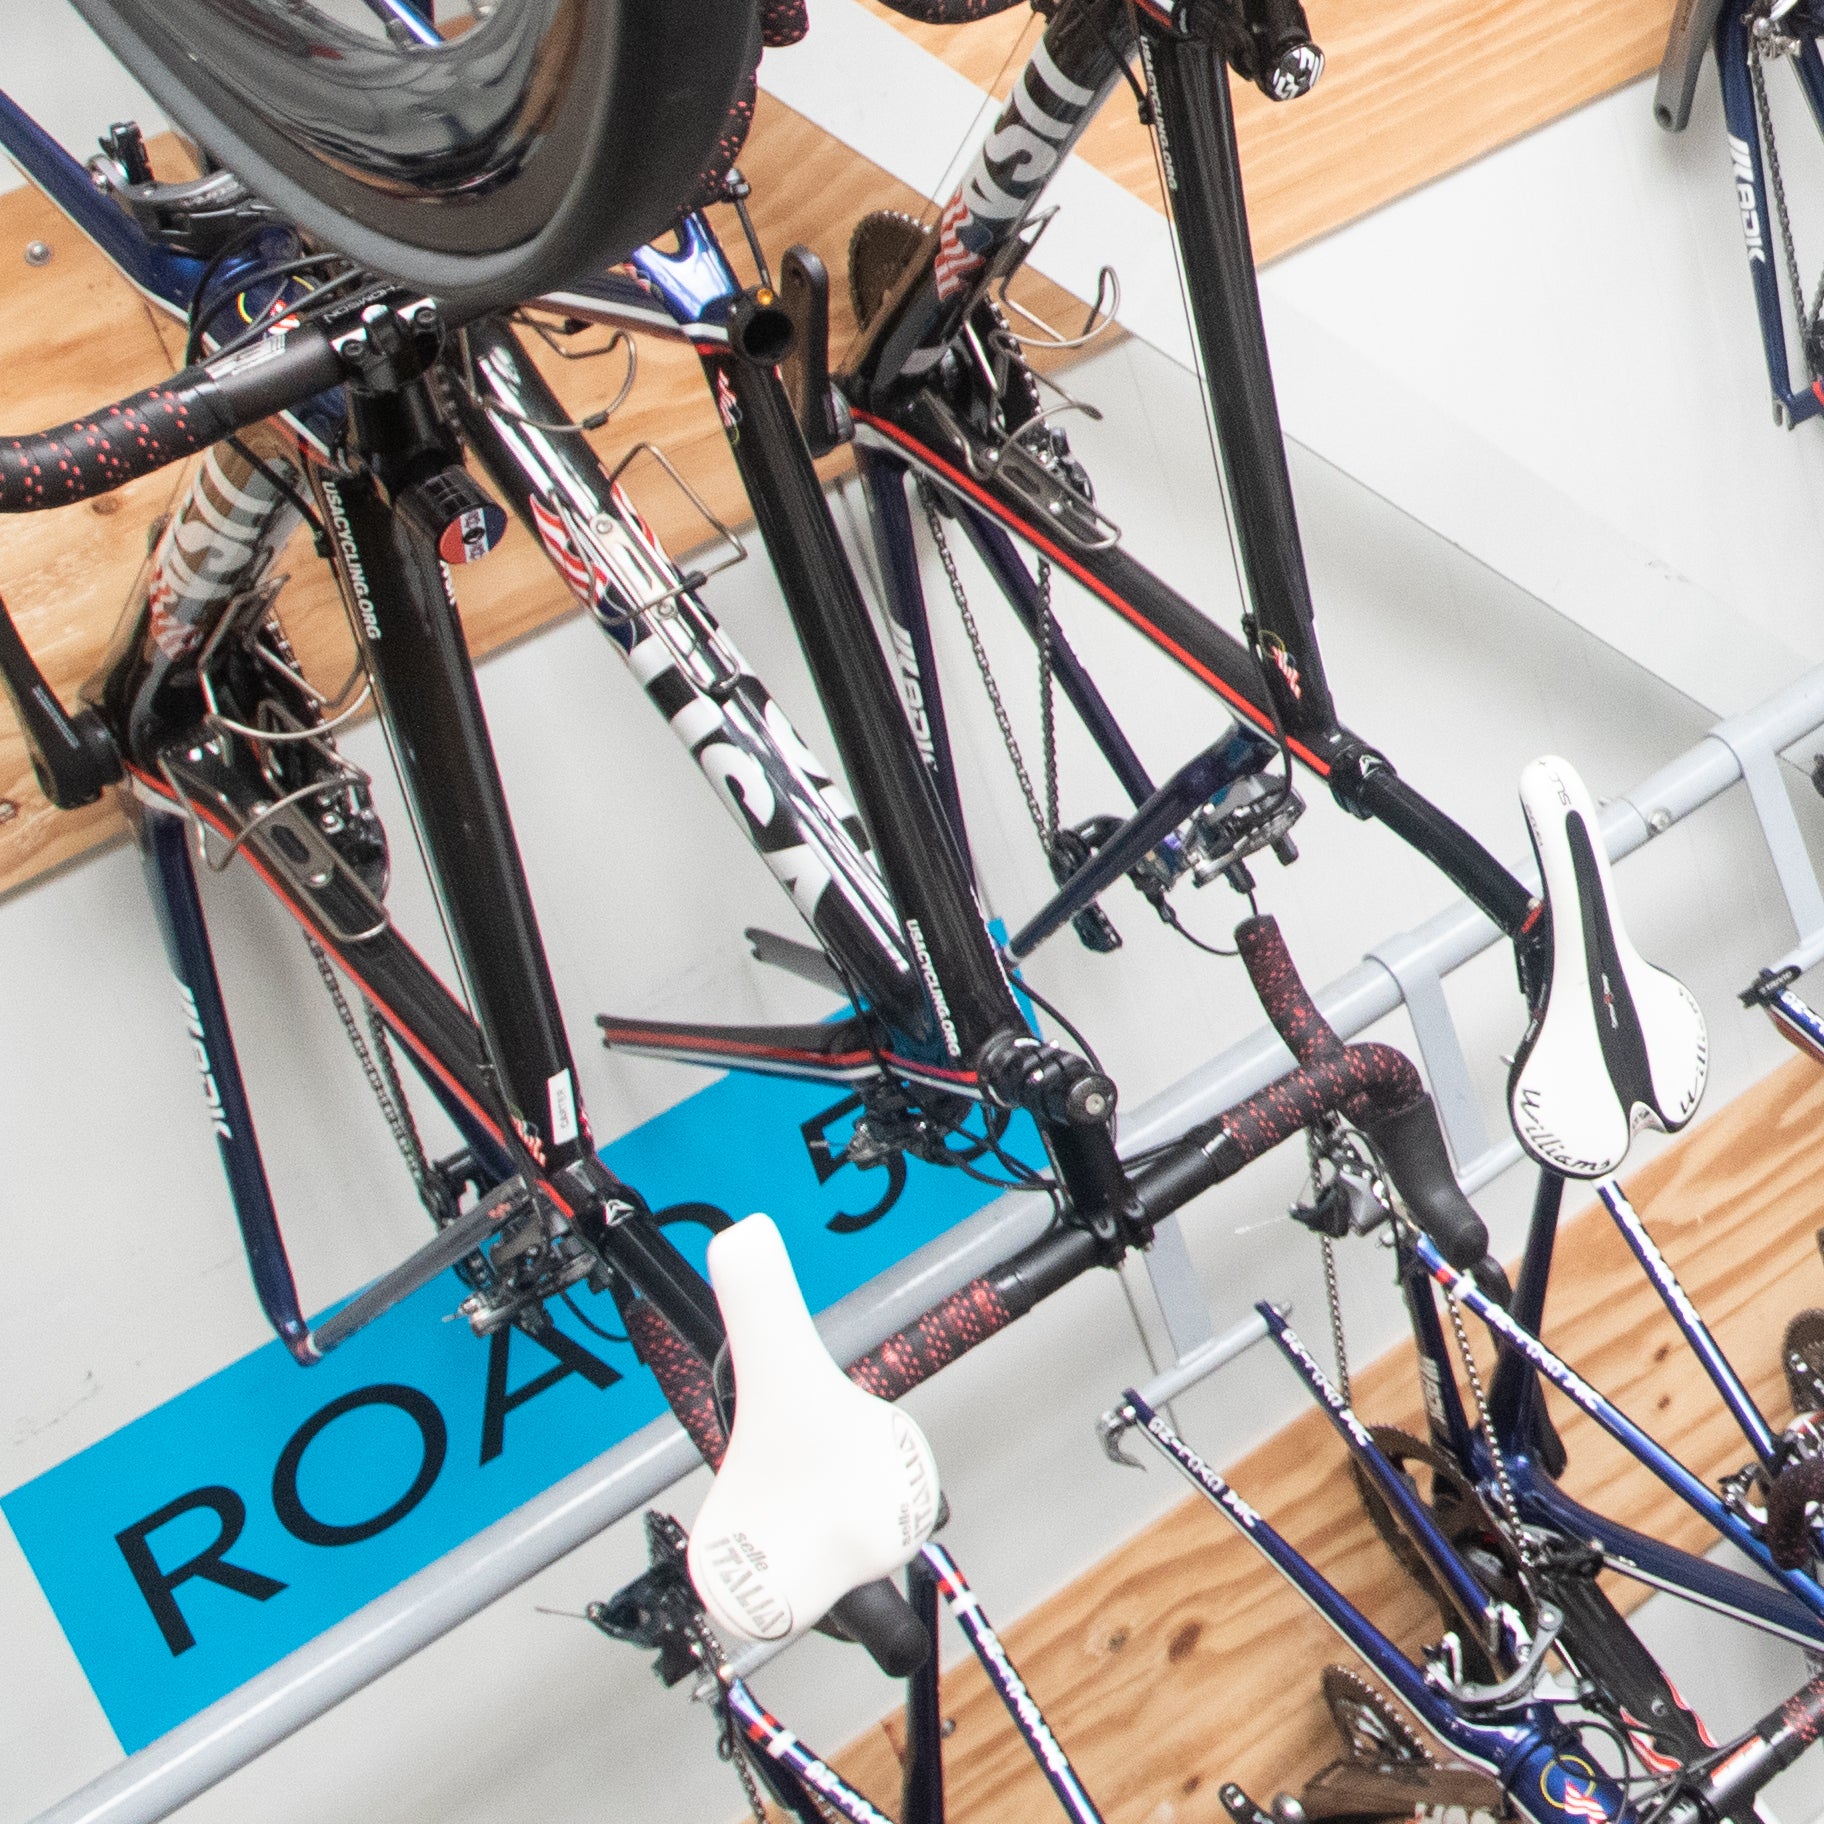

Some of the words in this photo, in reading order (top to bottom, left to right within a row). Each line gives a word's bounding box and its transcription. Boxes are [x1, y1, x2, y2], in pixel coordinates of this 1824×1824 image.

[961, 41, 1096, 221] USA
[1139, 34, 1179, 193] USACYCLING.ORG
[1733, 181, 1765, 262] ADK
[323, 283, 398, 324] HOMSON
[322, 481, 383, 642] USACYCLING.ORG
[904, 917, 963, 1059] USACYCLING.ORG
[1518, 1087, 1612, 1174] Williams
[1279, 1327, 1345, 1409] CYCLING
[1147, 1409, 1228, 1499] CYCLING
[1222, 1486, 1258, 1526] USA
[704, 1535, 789, 1635] ITALIA
[732, 1529, 772, 1574] selle
